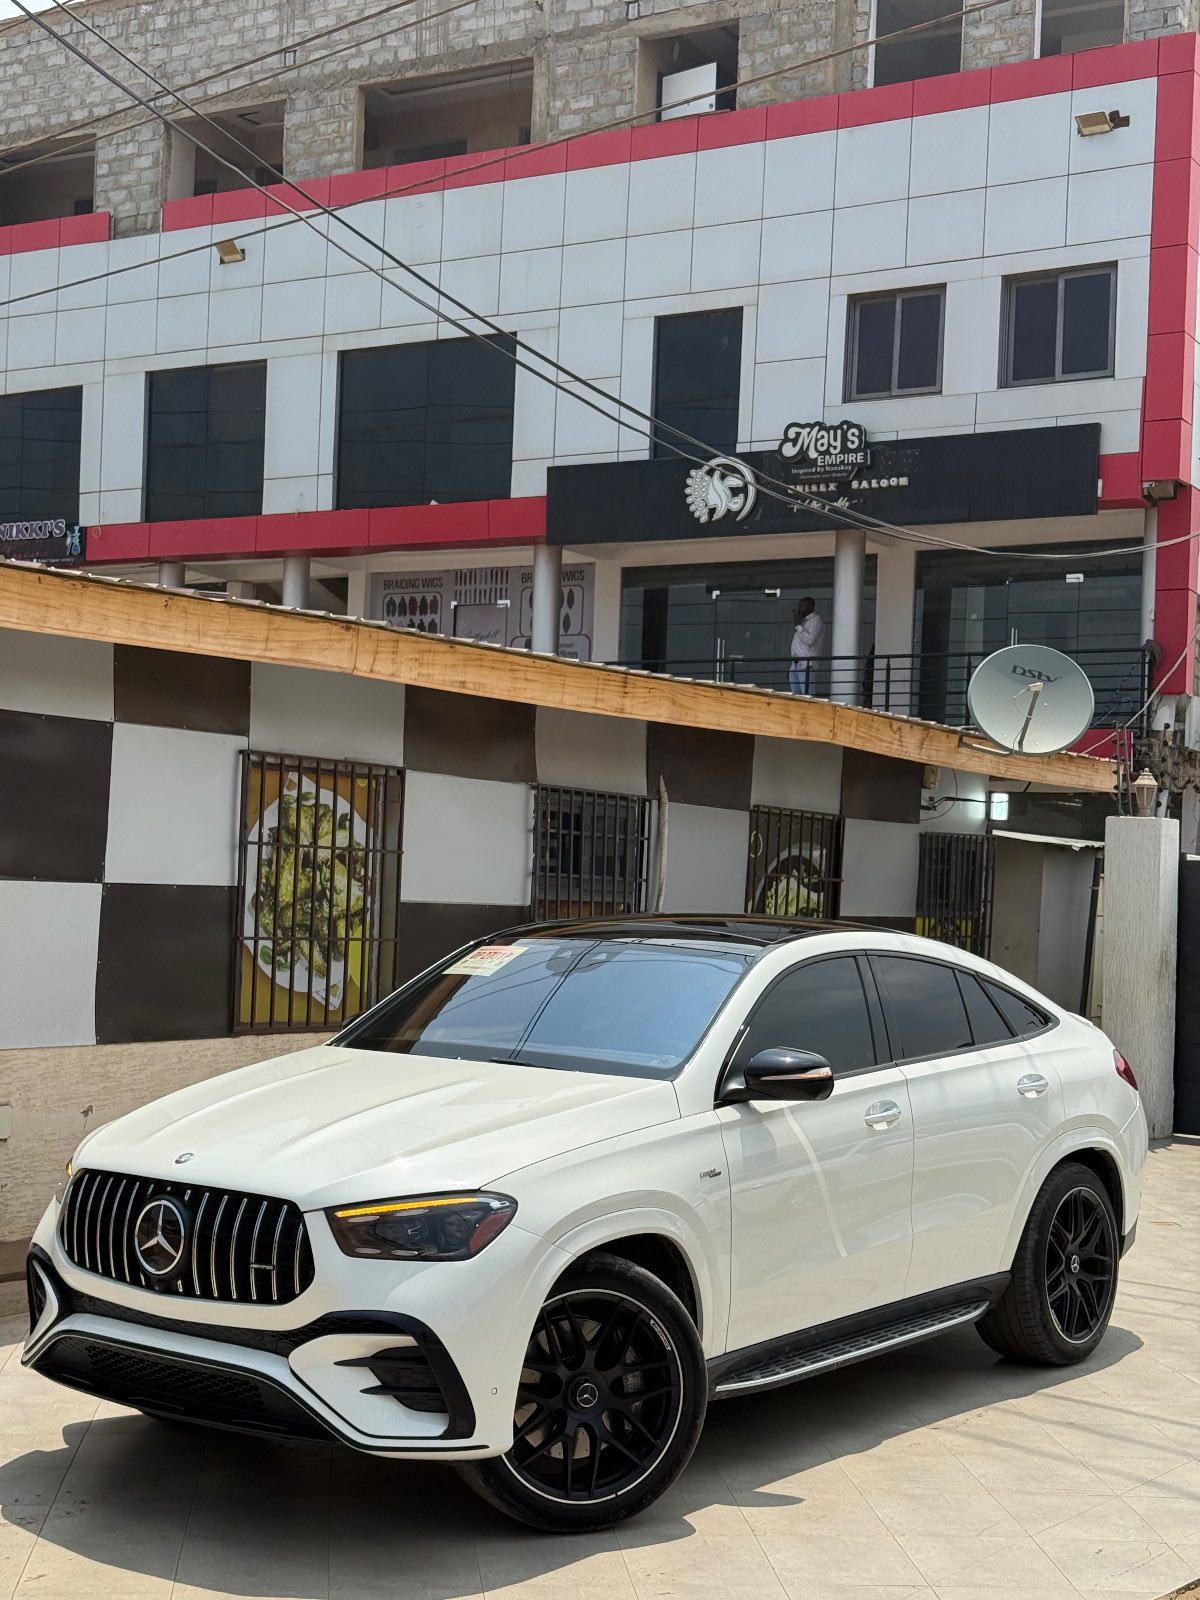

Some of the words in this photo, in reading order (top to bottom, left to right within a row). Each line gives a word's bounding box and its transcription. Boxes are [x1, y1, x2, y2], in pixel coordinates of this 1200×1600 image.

[782, 425, 860, 459] May's
[817, 452, 865, 466] EMPIRE
[791, 466, 816, 475] Inspired
[851, 477, 909, 490] SALOON
[561, 570, 585, 582] WIGS
[383, 578, 420, 591] BRAIDING
[421, 577, 444, 589] WIGS
